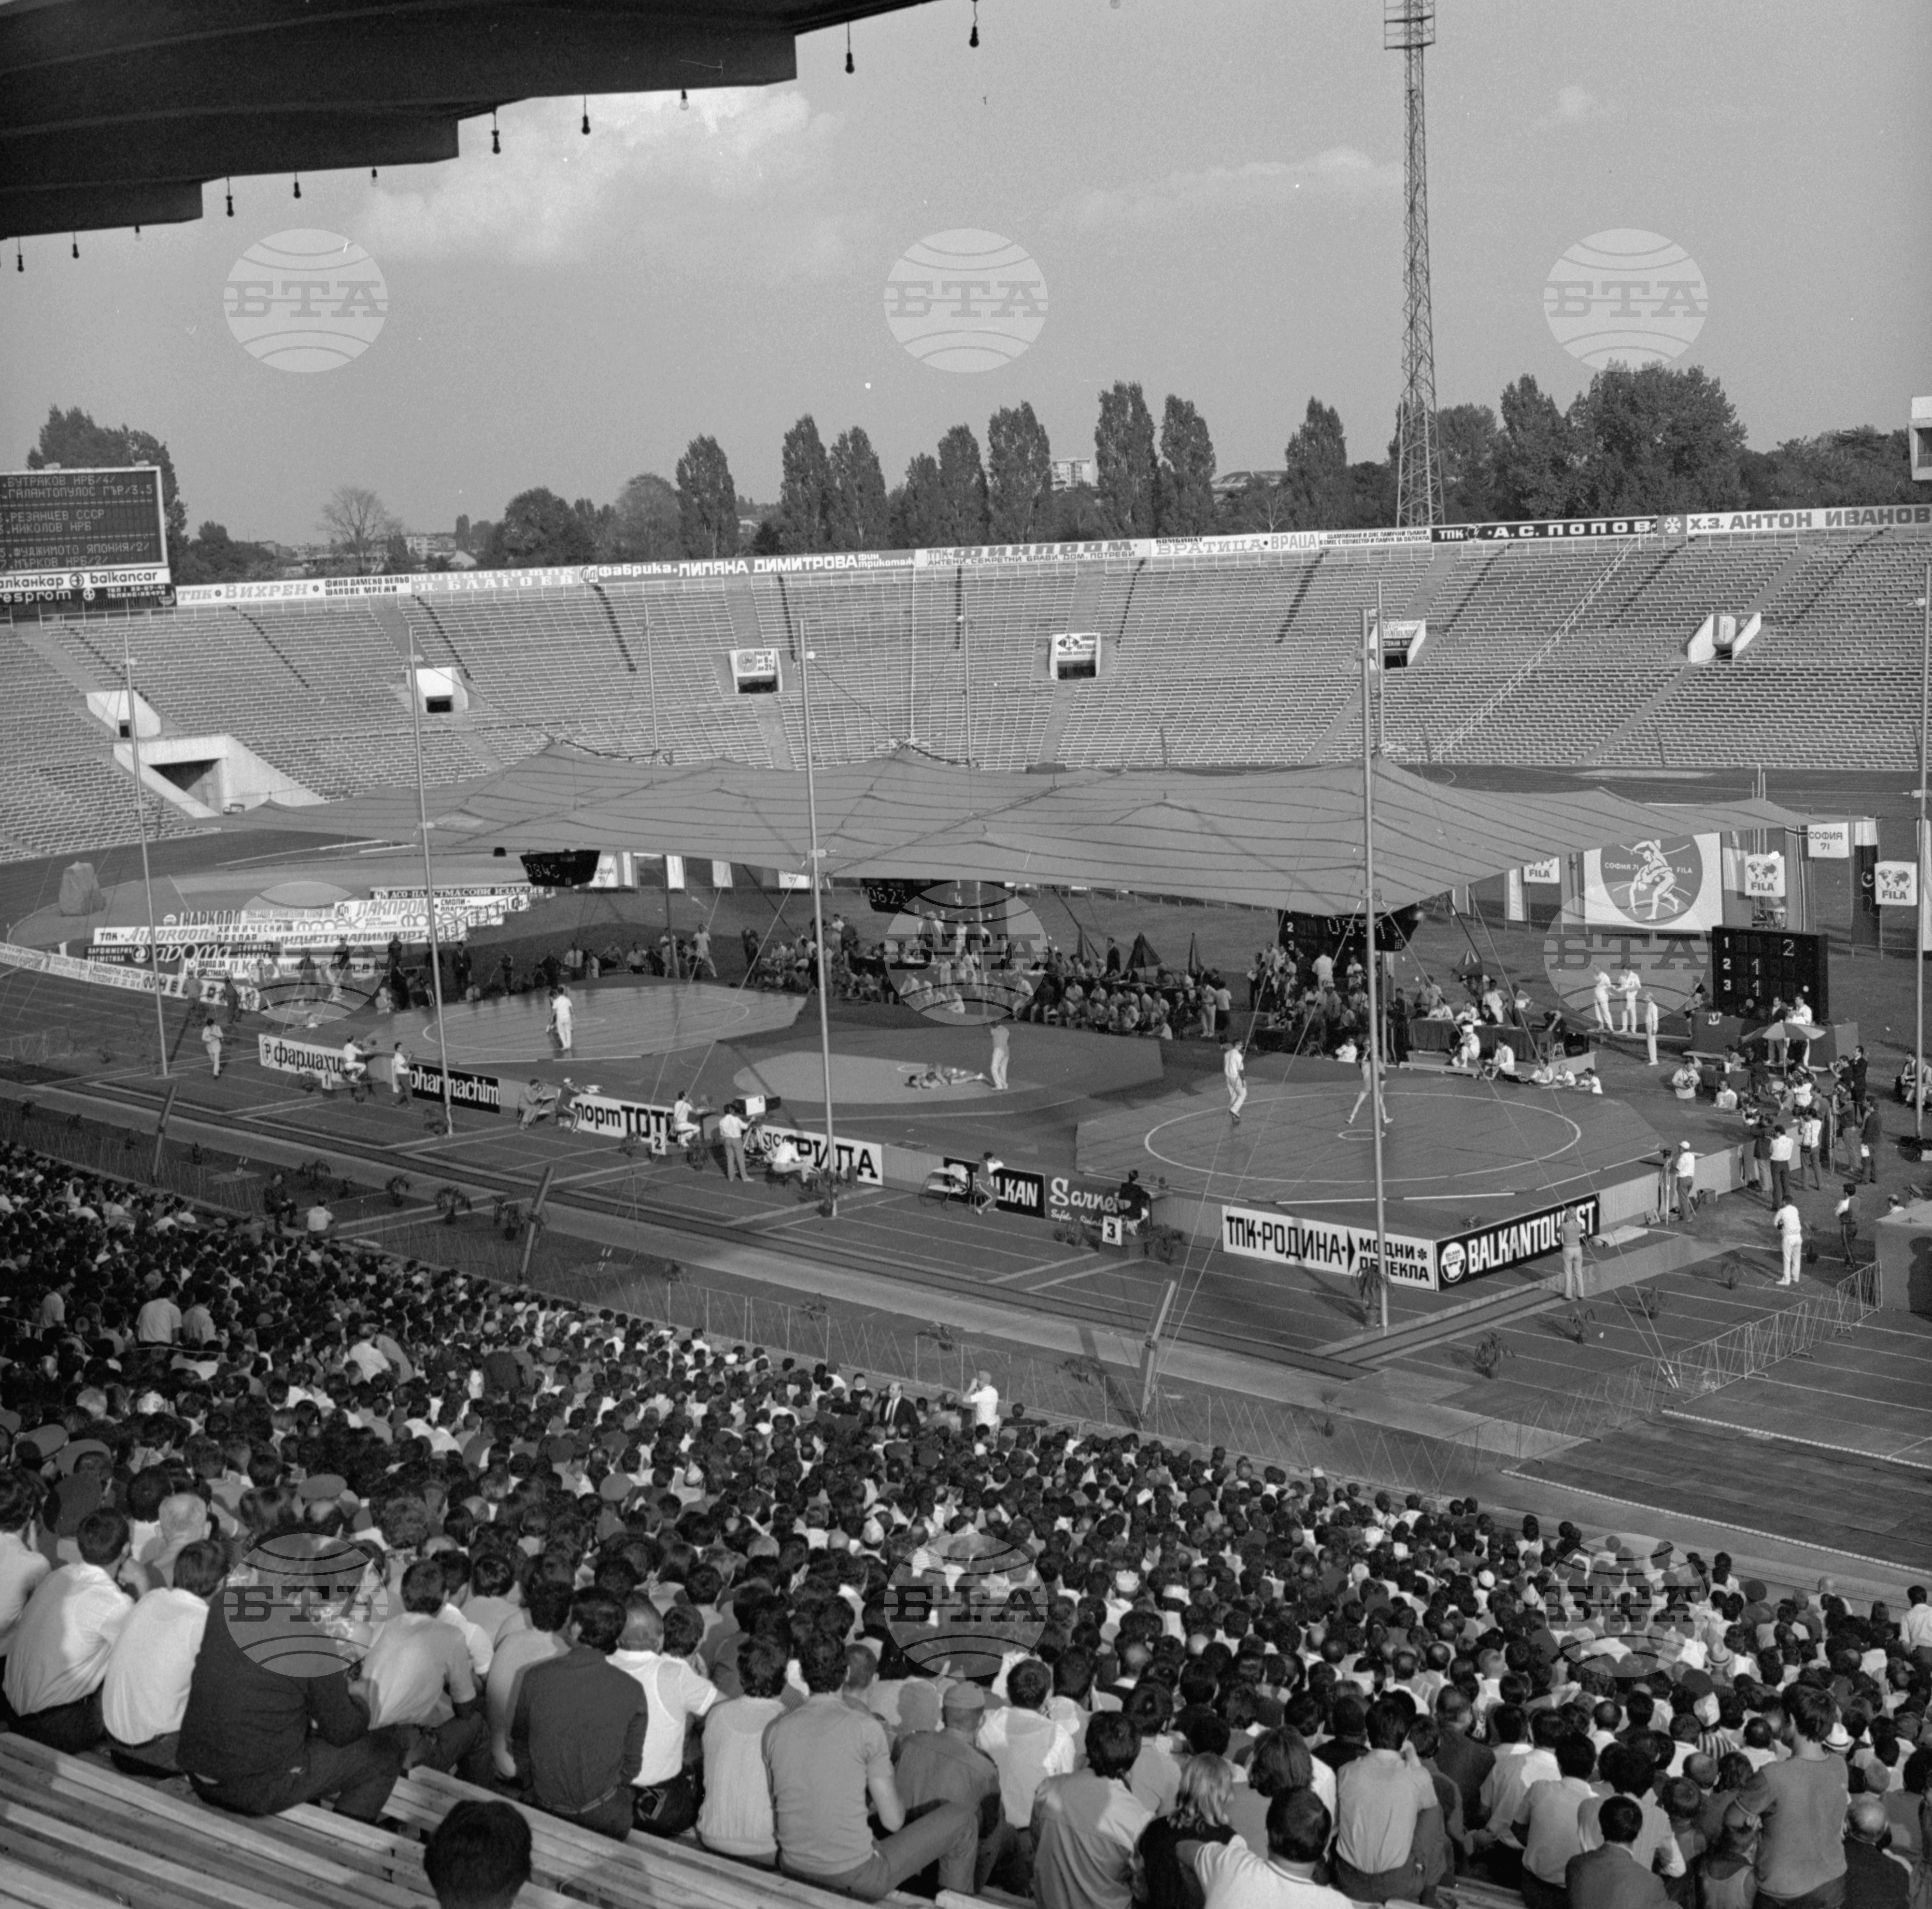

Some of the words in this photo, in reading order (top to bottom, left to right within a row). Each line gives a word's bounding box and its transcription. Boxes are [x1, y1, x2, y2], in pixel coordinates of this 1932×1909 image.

[103, 484, 152, 495] ГЪР/3.5
[77, 510, 104, 520] СССР
[1730, 512, 1813, 530] АНТОН
[1825, 507, 1932, 527] ИВАНОВ
[71, 521, 92, 531] НРБ
[1439, 530, 1463, 540] ТПК
[1548, 520, 1651, 536] ПОПОВ
[87, 542, 149, 554] ЯПОНИЯ/2/
[927, 550, 948, 559] ТПК
[953, 541, 1132, 559] ФИНПРОМ
[1157, 539, 1265, 556] ВРАТИЦА
[1271, 534, 1317, 550] ВРАЦА
[66, 556, 108, 566] НРБ/2/
[679, 560, 749, 577] ЛИЛЯНА
[753, 555, 858, 573] ДИМИТРОВА
[971, 556, 1022, 564] СЕКРЕТНИ
[90, 572, 157, 584] balkancar
[325, 579, 348, 588] ФИНО
[350, 577, 383, 586] ДАМСКО
[385, 576, 410, 584] БЕЛЬО
[448, 575, 573, 591] БЛАГОЕВ
[178, 589, 213, 600] ТПК
[224, 583, 309, 599] ВИХРЕН
[325, 587, 360, 596] ШАЛОВЕ
[1809, 831, 1843, 840] СОФИЯ
[1529, 869, 1550, 878] FILA
[412, 888, 481, 898] ПЛСТМАСОВИ
[1751, 883, 1775, 892] FILA
[1882, 890, 1907, 900] FILA
[1287, 922, 1294, 932] 2
[100, 932, 118, 941] ТПК
[1723, 937, 1729, 948] 1
[1783, 939, 1794, 956] 2
[1723, 958, 1731, 970] 2
[1752, 958, 1759, 975] 1
[1723, 980, 1731, 991] 3
[1752, 980, 1759, 997] 1
[274, 1040, 344, 1074] фармахи
[325, 1073, 328, 1085] 1
[574, 1101, 622, 1130] порт
[654, 1136, 662, 1150] 2
[1107, 1222, 1116, 1239] 3
[1226, 1215, 1256, 1249] ТПК
[1262, 1221, 1343, 1266] РОДИНА
[1467, 1200, 1596, 1274] BALKANTOUST
